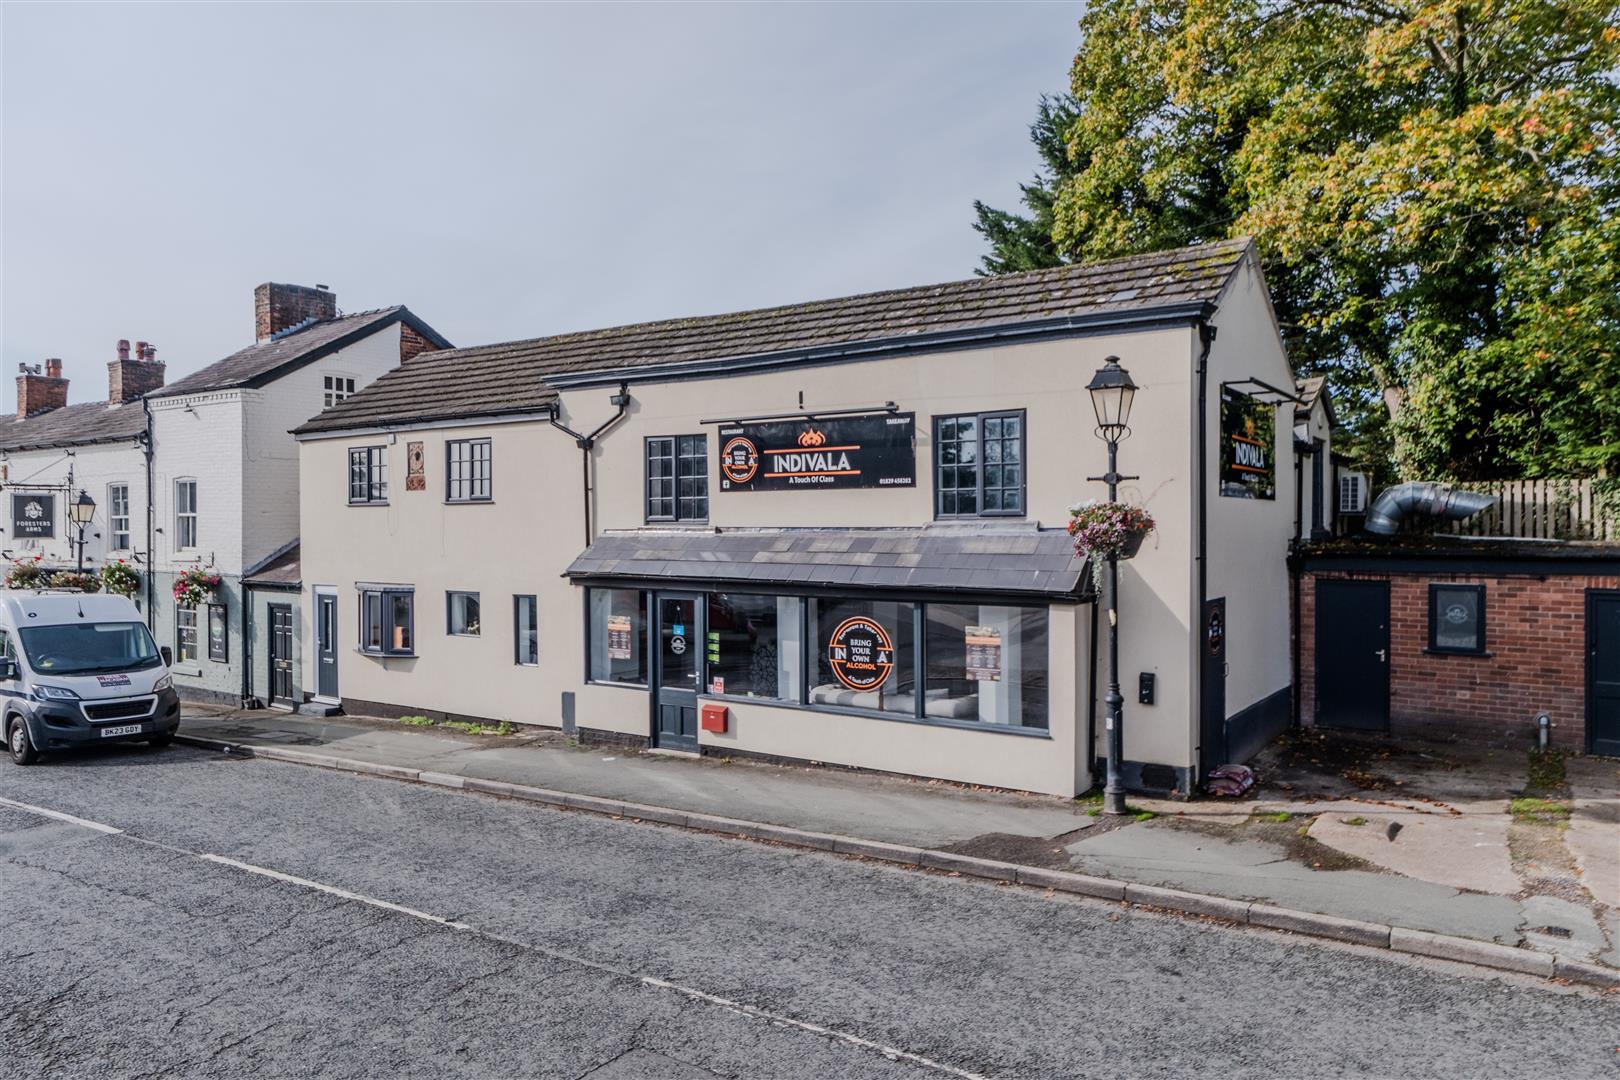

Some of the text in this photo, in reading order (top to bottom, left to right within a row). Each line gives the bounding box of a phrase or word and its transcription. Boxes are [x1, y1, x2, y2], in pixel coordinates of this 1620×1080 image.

[1235, 441, 1265, 468] INDIVALA
[773, 451, 851, 473] INDIVALA
[811, 475, 818, 483] Of
[851, 646, 871, 655] YOUR
[852, 655, 870, 663] OWN
[846, 662, 876, 670] ALCOHOL
[104, 725, 139, 736] BK23 GDY
